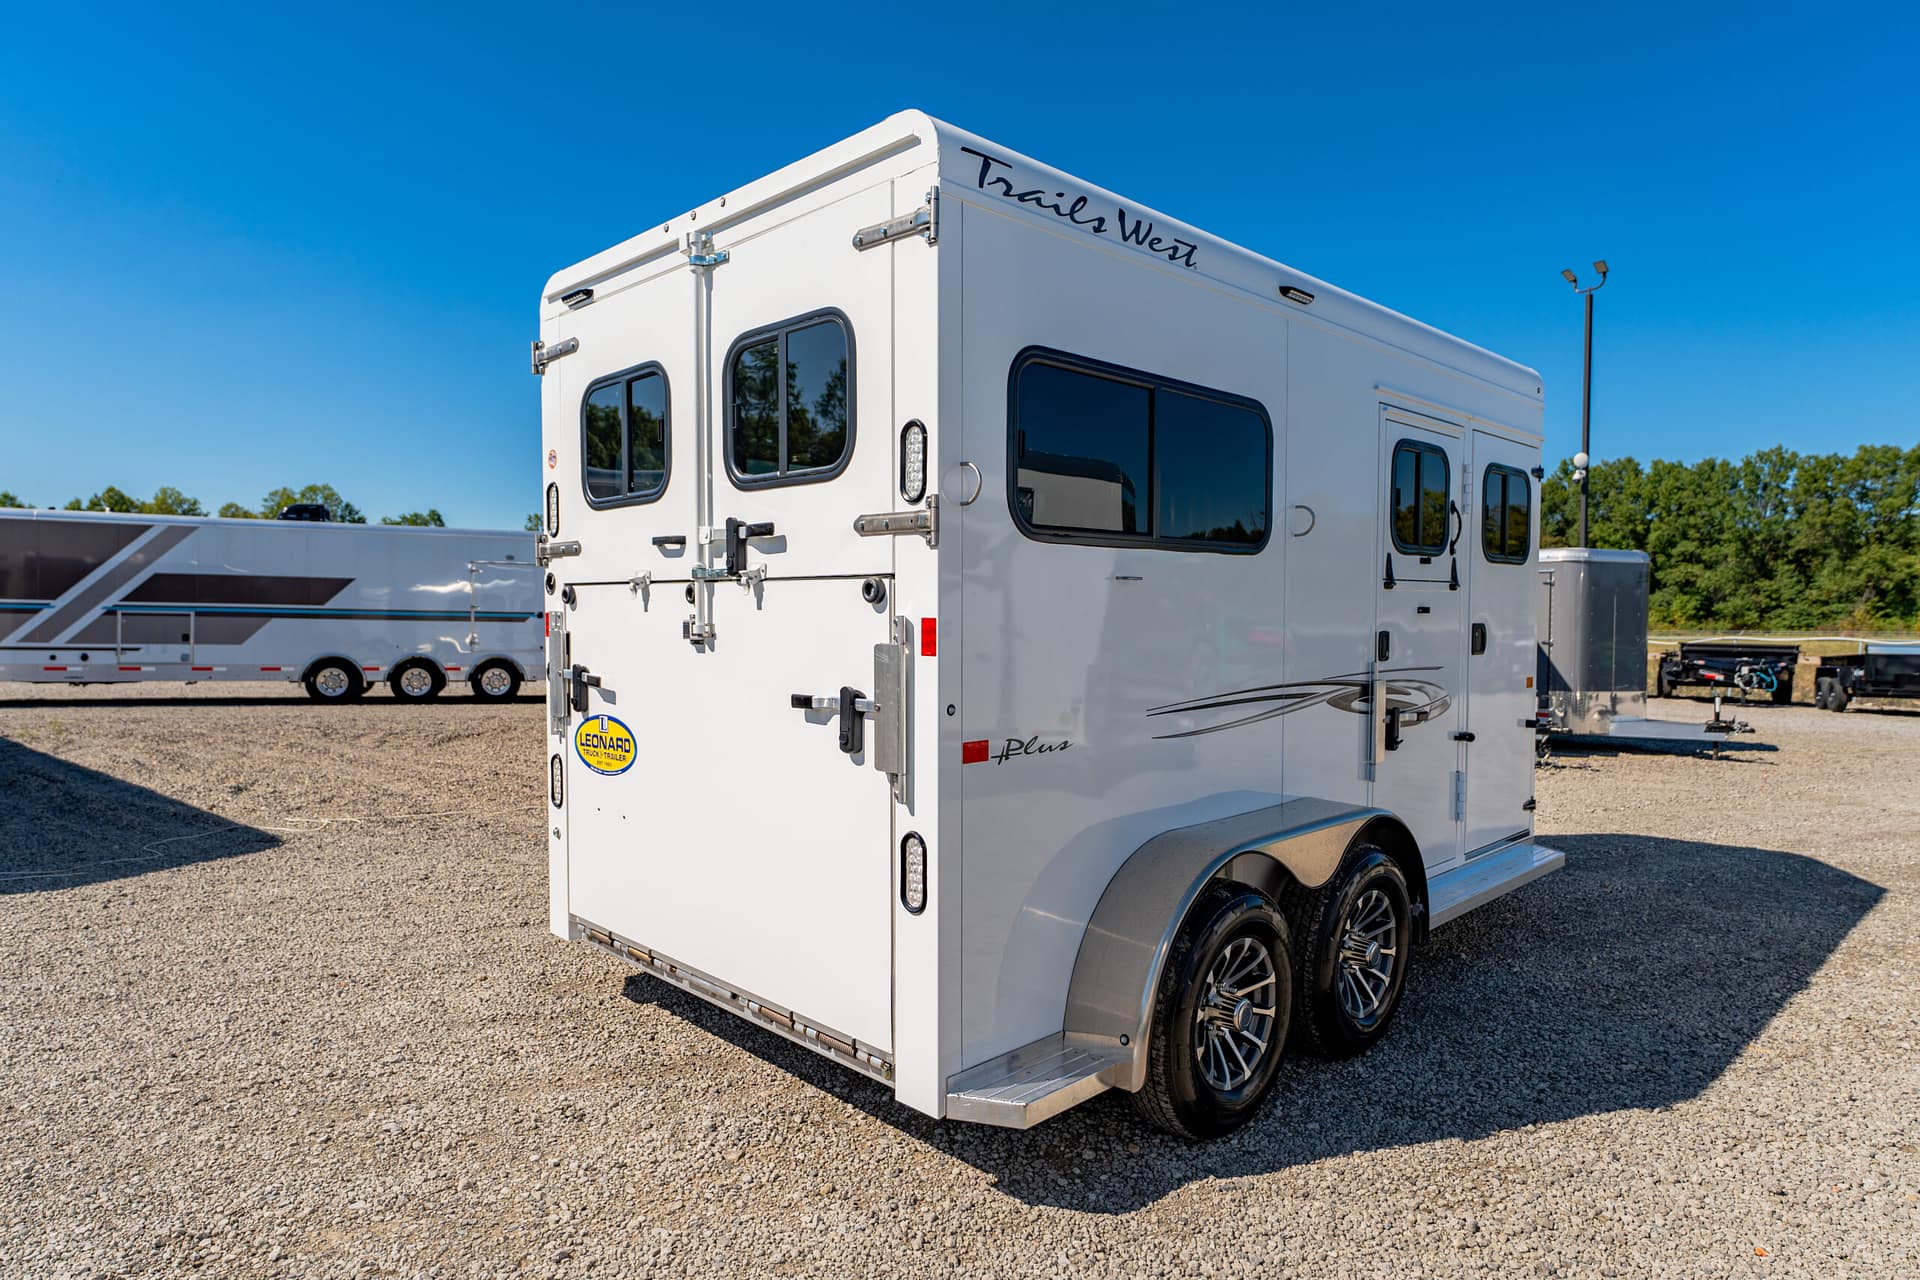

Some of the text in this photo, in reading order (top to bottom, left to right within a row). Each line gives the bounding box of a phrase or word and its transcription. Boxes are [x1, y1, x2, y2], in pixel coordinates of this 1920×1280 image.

[961, 147, 1198, 268] Trails West
[580, 732, 631, 753] LEONARD
[583, 749, 599, 757] TRUCK
[603, 752, 627, 762] TRAILER
